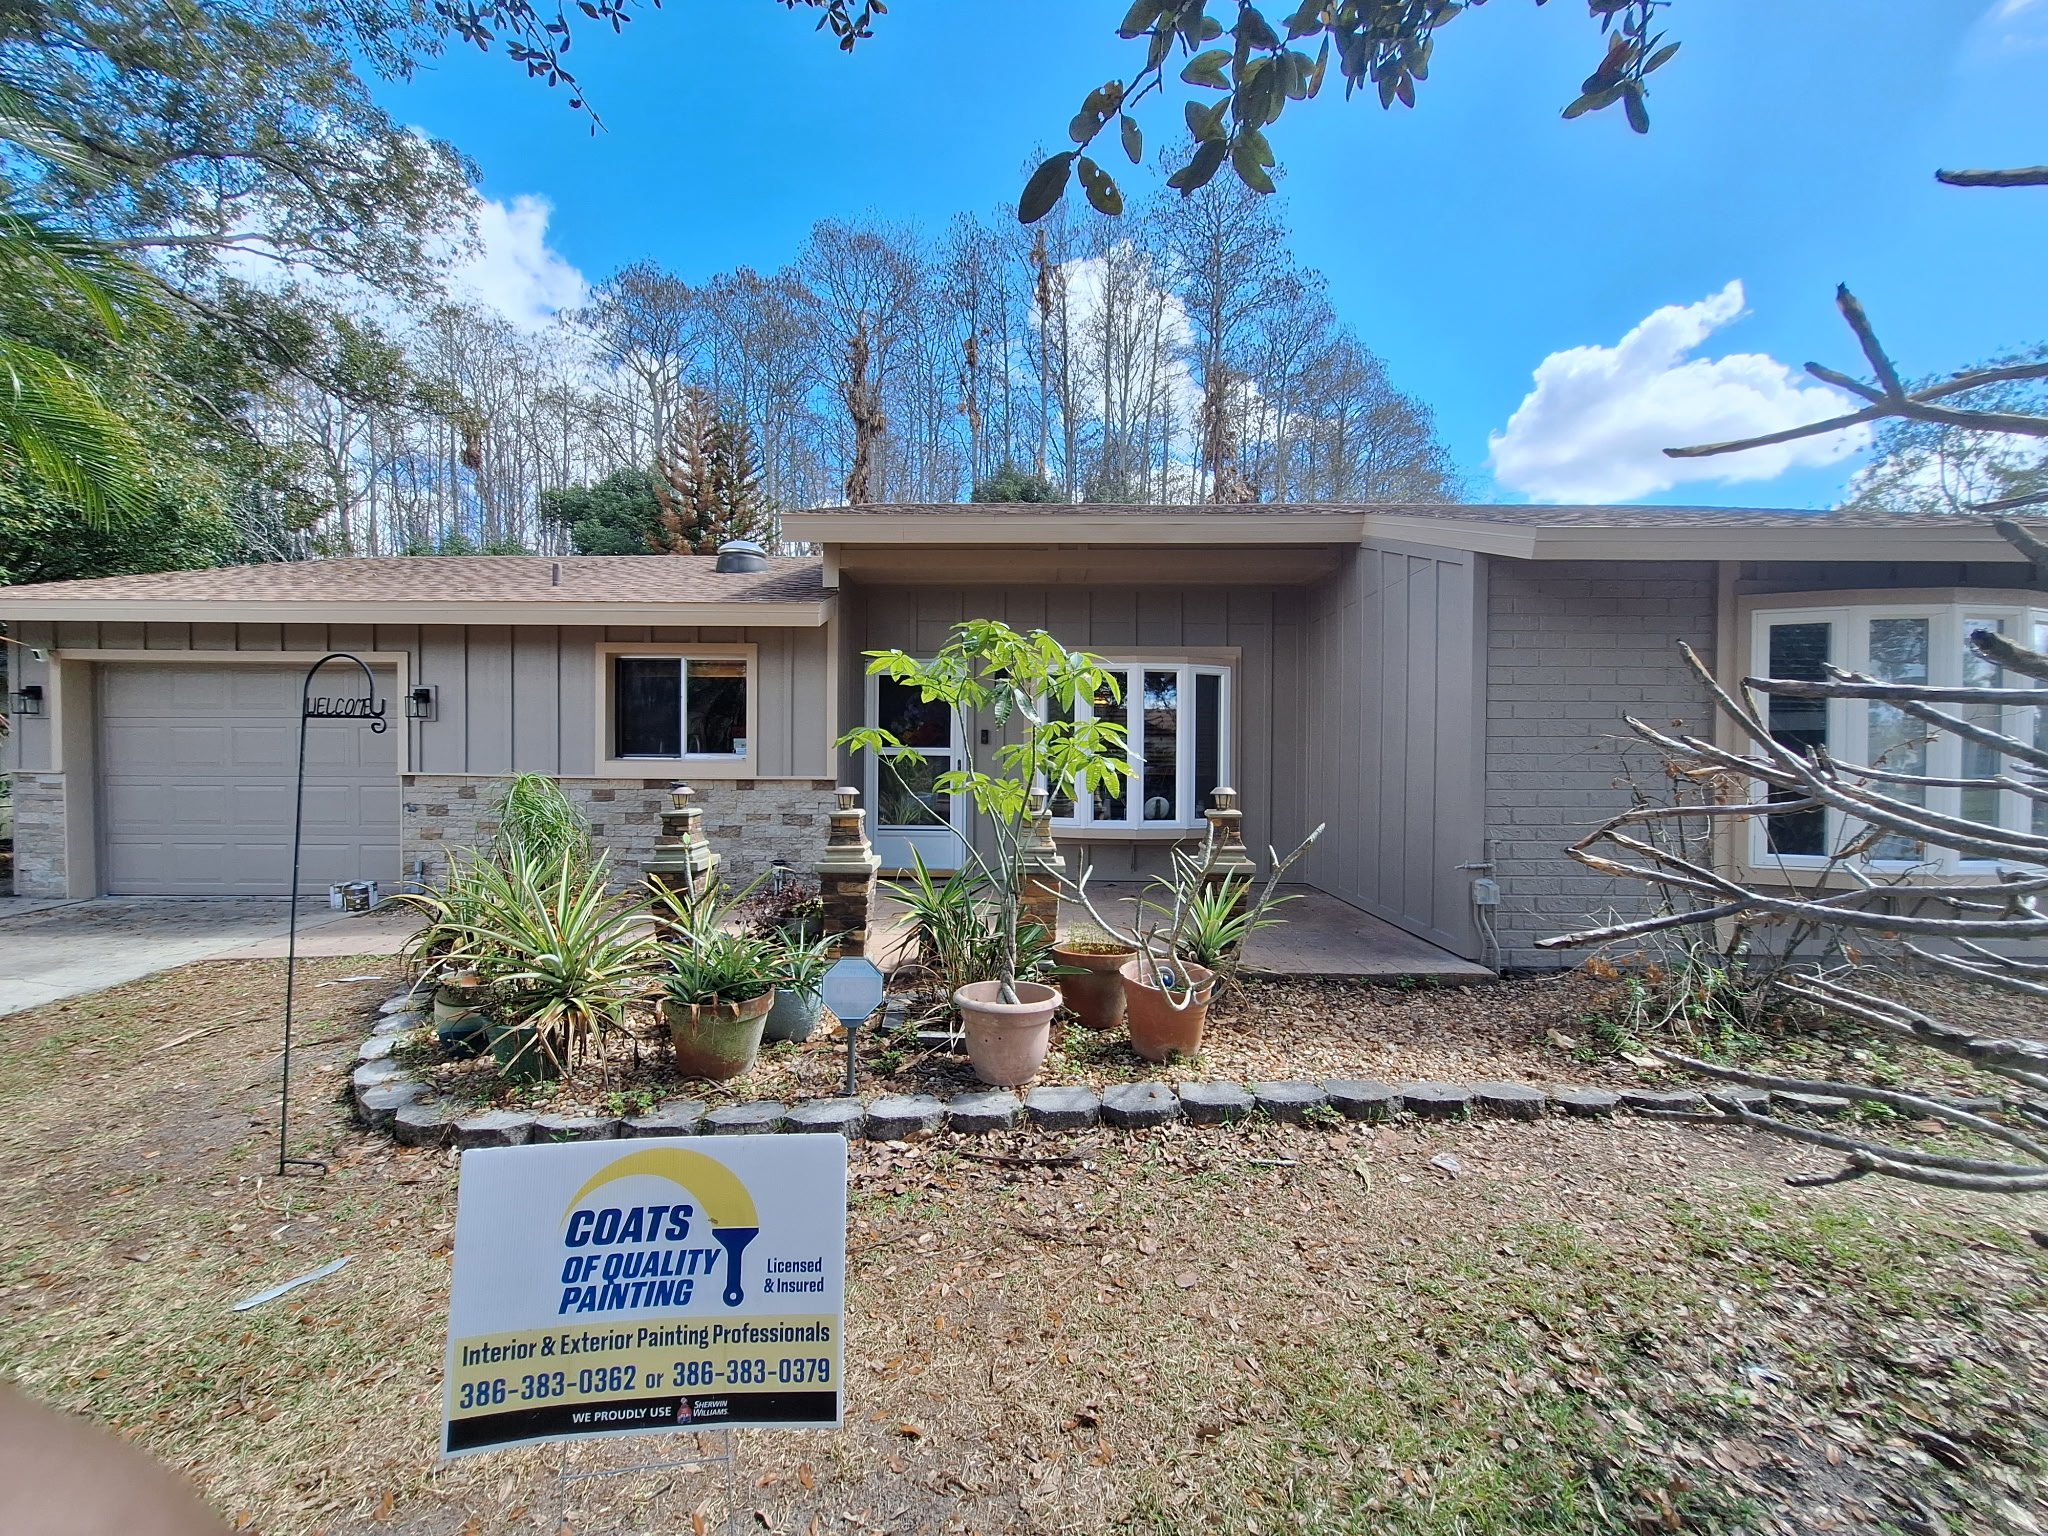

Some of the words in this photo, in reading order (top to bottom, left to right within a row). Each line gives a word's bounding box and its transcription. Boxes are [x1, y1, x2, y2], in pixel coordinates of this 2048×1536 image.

[306, 697, 372, 715] WELCOME
[564, 1204, 694, 1248] COATS
[561, 1254, 602, 1284] OF
[602, 1248, 722, 1285] QUALITY
[767, 1256, 822, 1274] Licensed
[764, 1278, 774, 1293] &
[777, 1277, 824, 1293] Insured
[558, 1279, 694, 1315] PAINTING
[462, 1338, 537, 1367] Interior
[540, 1336, 557, 1357] &
[560, 1329, 634, 1355] Exterior
[637, 1324, 709, 1350] Painting
[712, 1321, 830, 1345] Professionals
[459, 1365, 636, 1409] 386-383-0362
[645, 1372, 664, 1389] or
[672, 1357, 830, 1387] 386-383-0379
[693, 1400, 728, 1409] SHERWIN
[693, 1408, 728, 1417] WILLIAMS
[572, 1413, 591, 1424] WE
[594, 1408, 647, 1422] PROUDLY
[650, 1406, 672, 1418] USE
